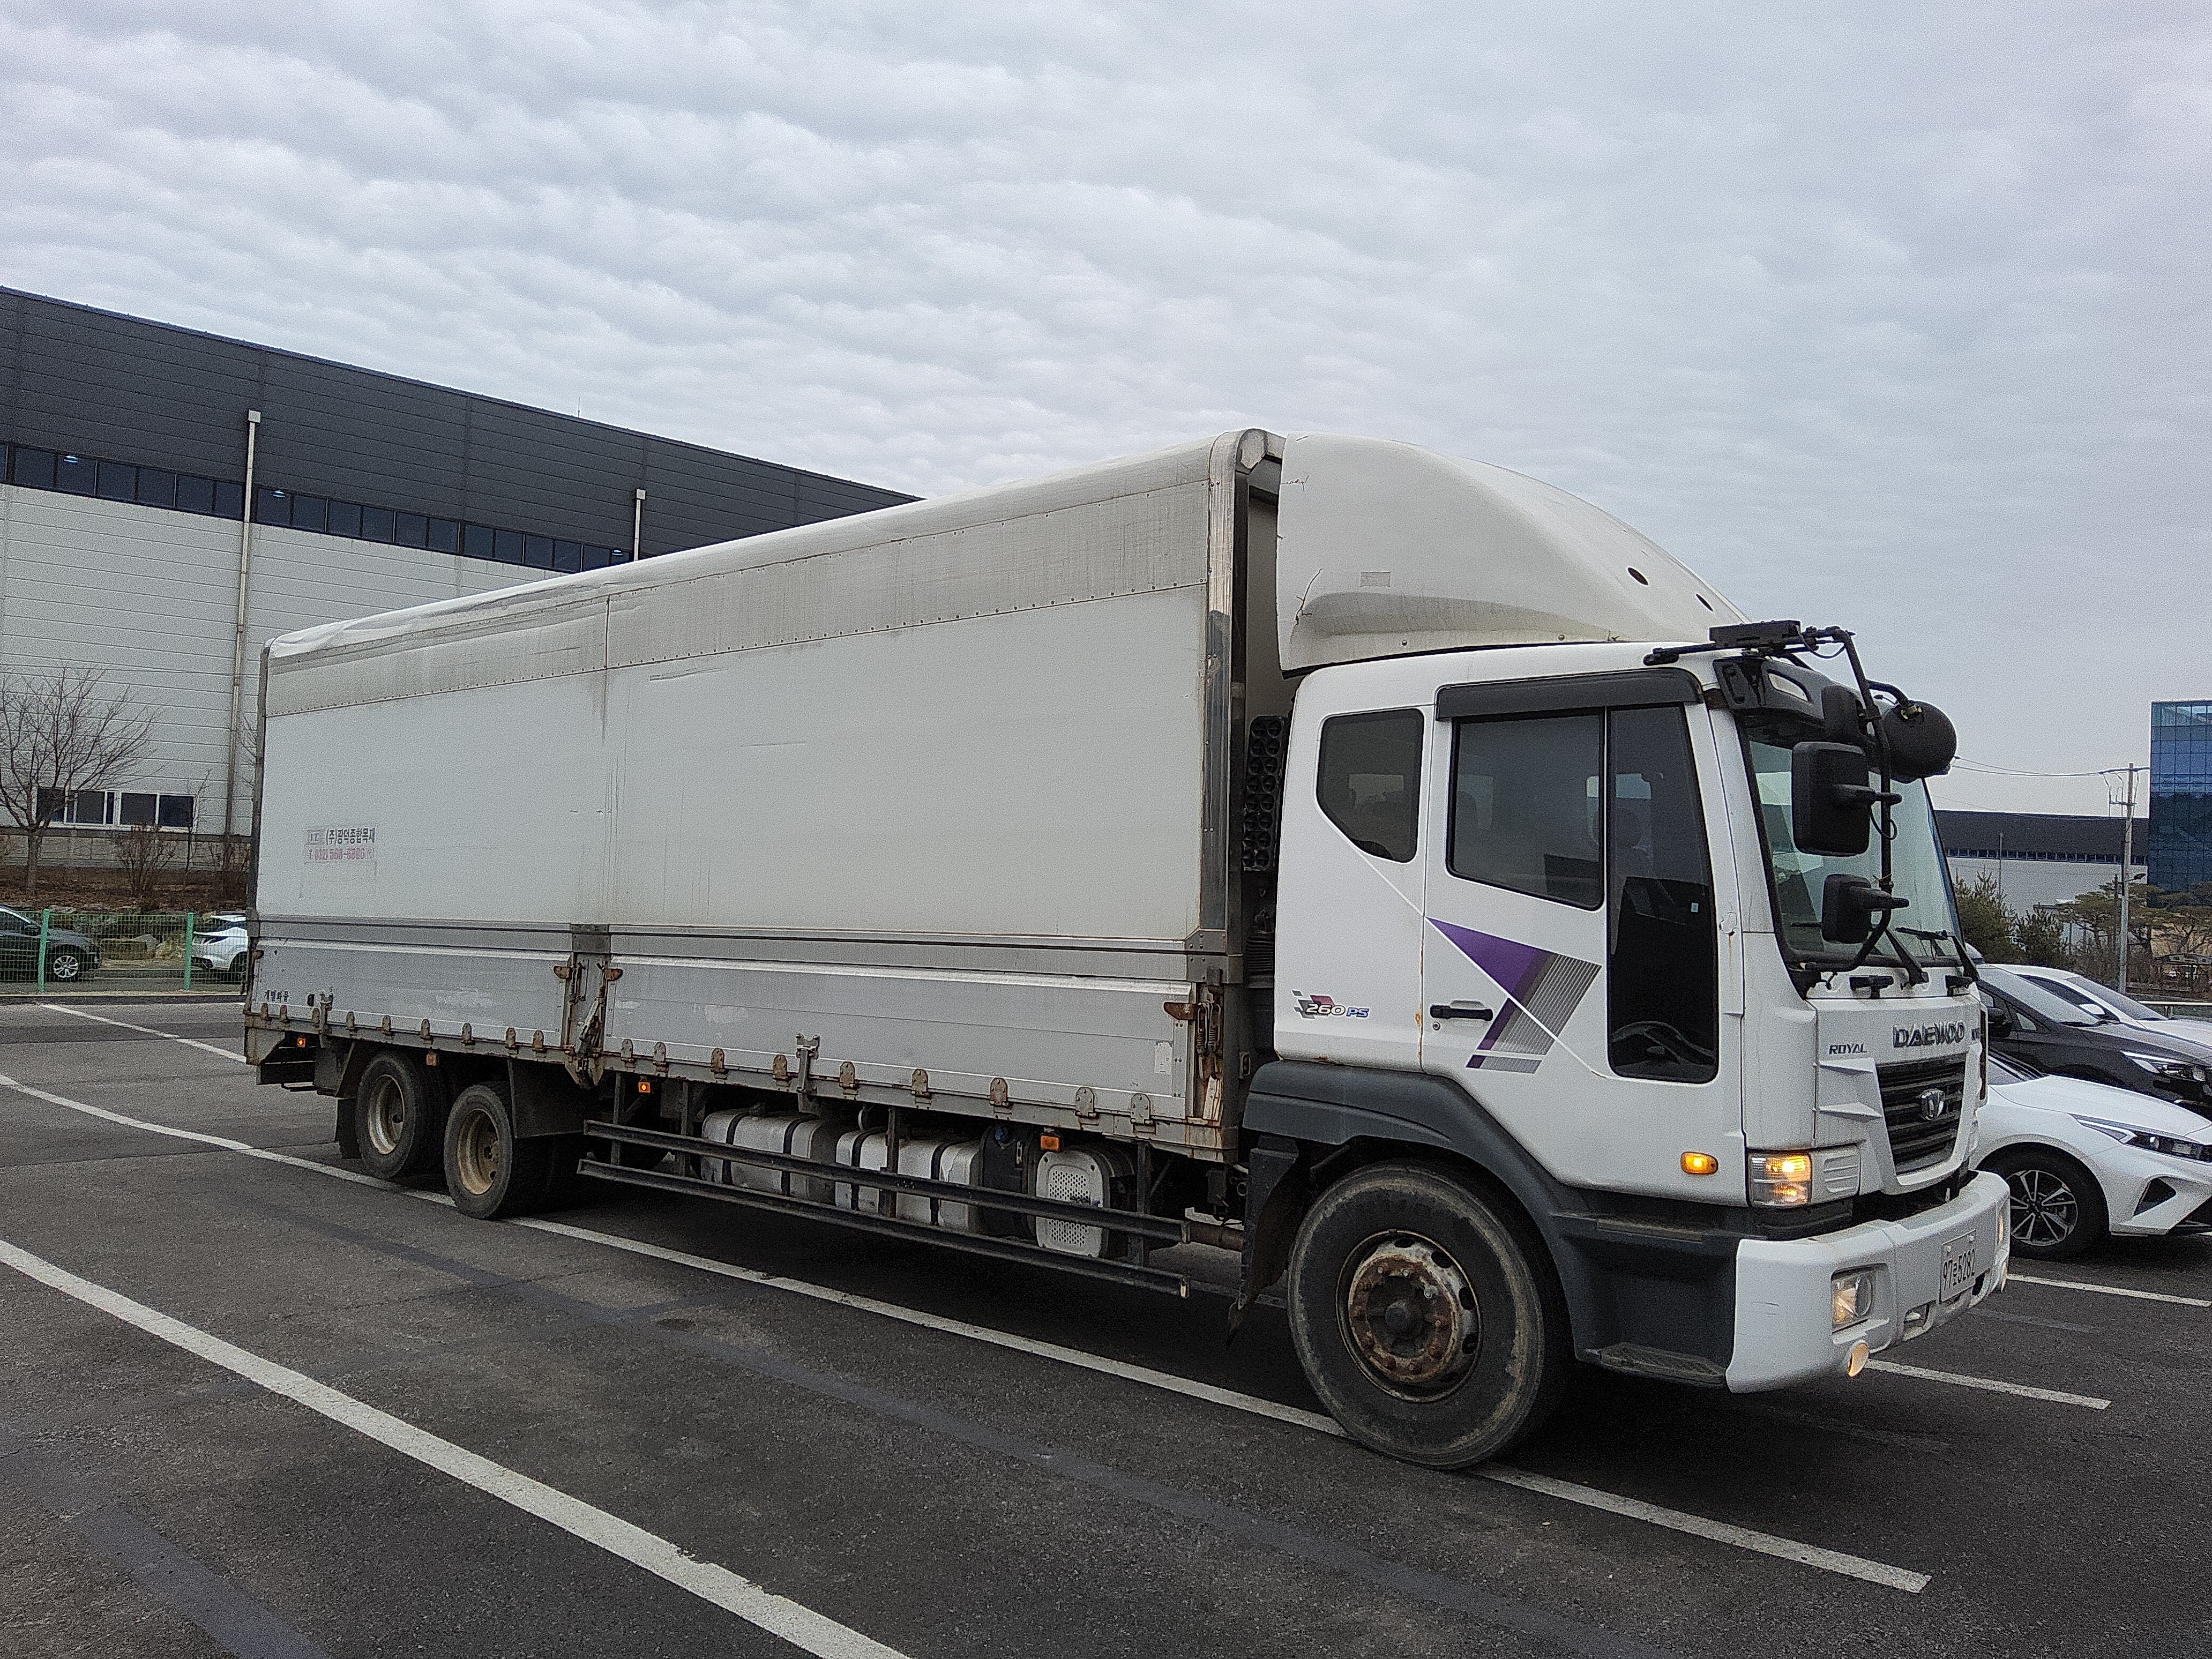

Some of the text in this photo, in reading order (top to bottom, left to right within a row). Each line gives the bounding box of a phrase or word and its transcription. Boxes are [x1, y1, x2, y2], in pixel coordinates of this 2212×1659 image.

[1305, 1003, 1370, 1018] 260 PS
[1893, 1021, 1965, 1048] DAEWOO
[1829, 1044, 1868, 1055] ROYAL
[1942, 1248, 1975, 1290] 97로5282
